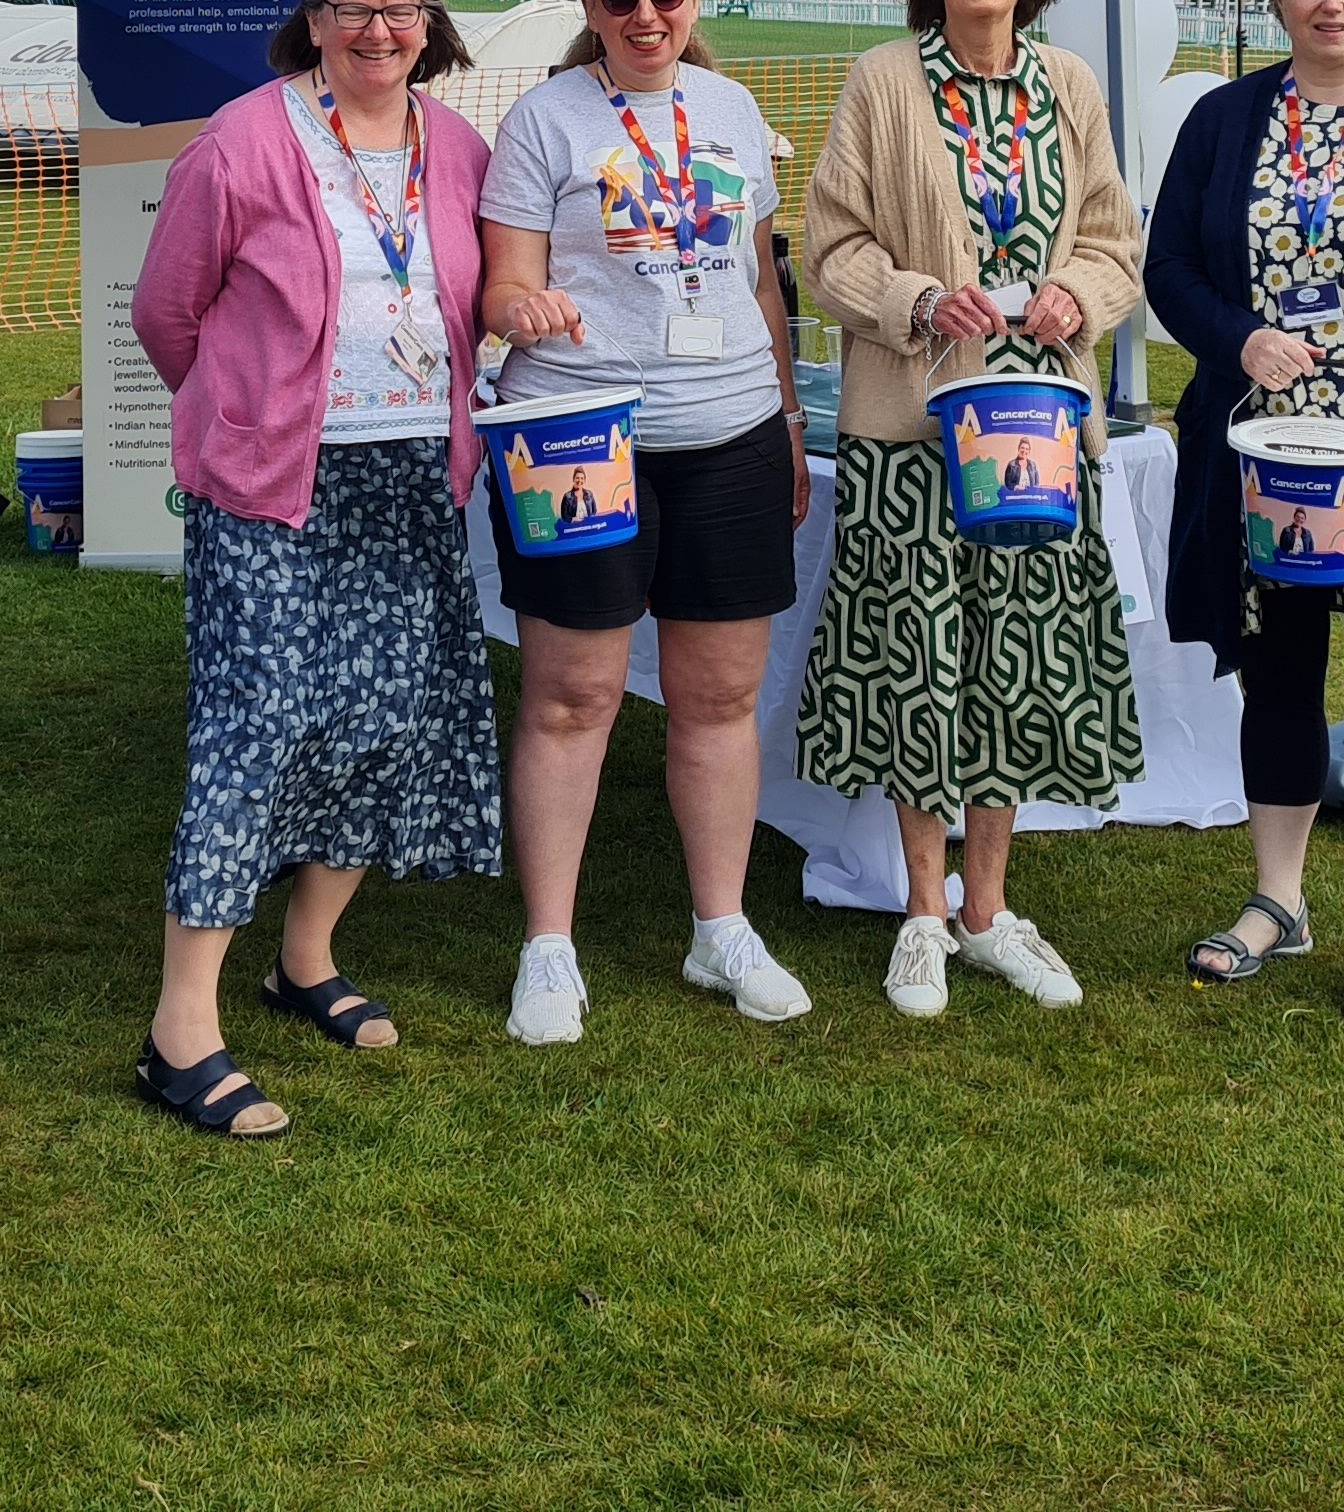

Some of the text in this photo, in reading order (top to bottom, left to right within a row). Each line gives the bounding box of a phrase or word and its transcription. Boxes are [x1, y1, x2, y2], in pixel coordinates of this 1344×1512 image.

[128, 5, 279, 19] professional help, emotional
[125, 21, 264, 34] collective strength to face
[635, 256, 736, 276] CancCar
[114, 370, 158, 381] jewellery
[991, 410, 1053, 421] CancerCare
[114, 422, 146, 430] Indian
[114, 440, 171, 449] Mindfulnes
[542, 434, 606, 452] CancerCare
[115, 458, 167, 468] Nutritional
[1270, 478, 1332, 491] CancerCare
